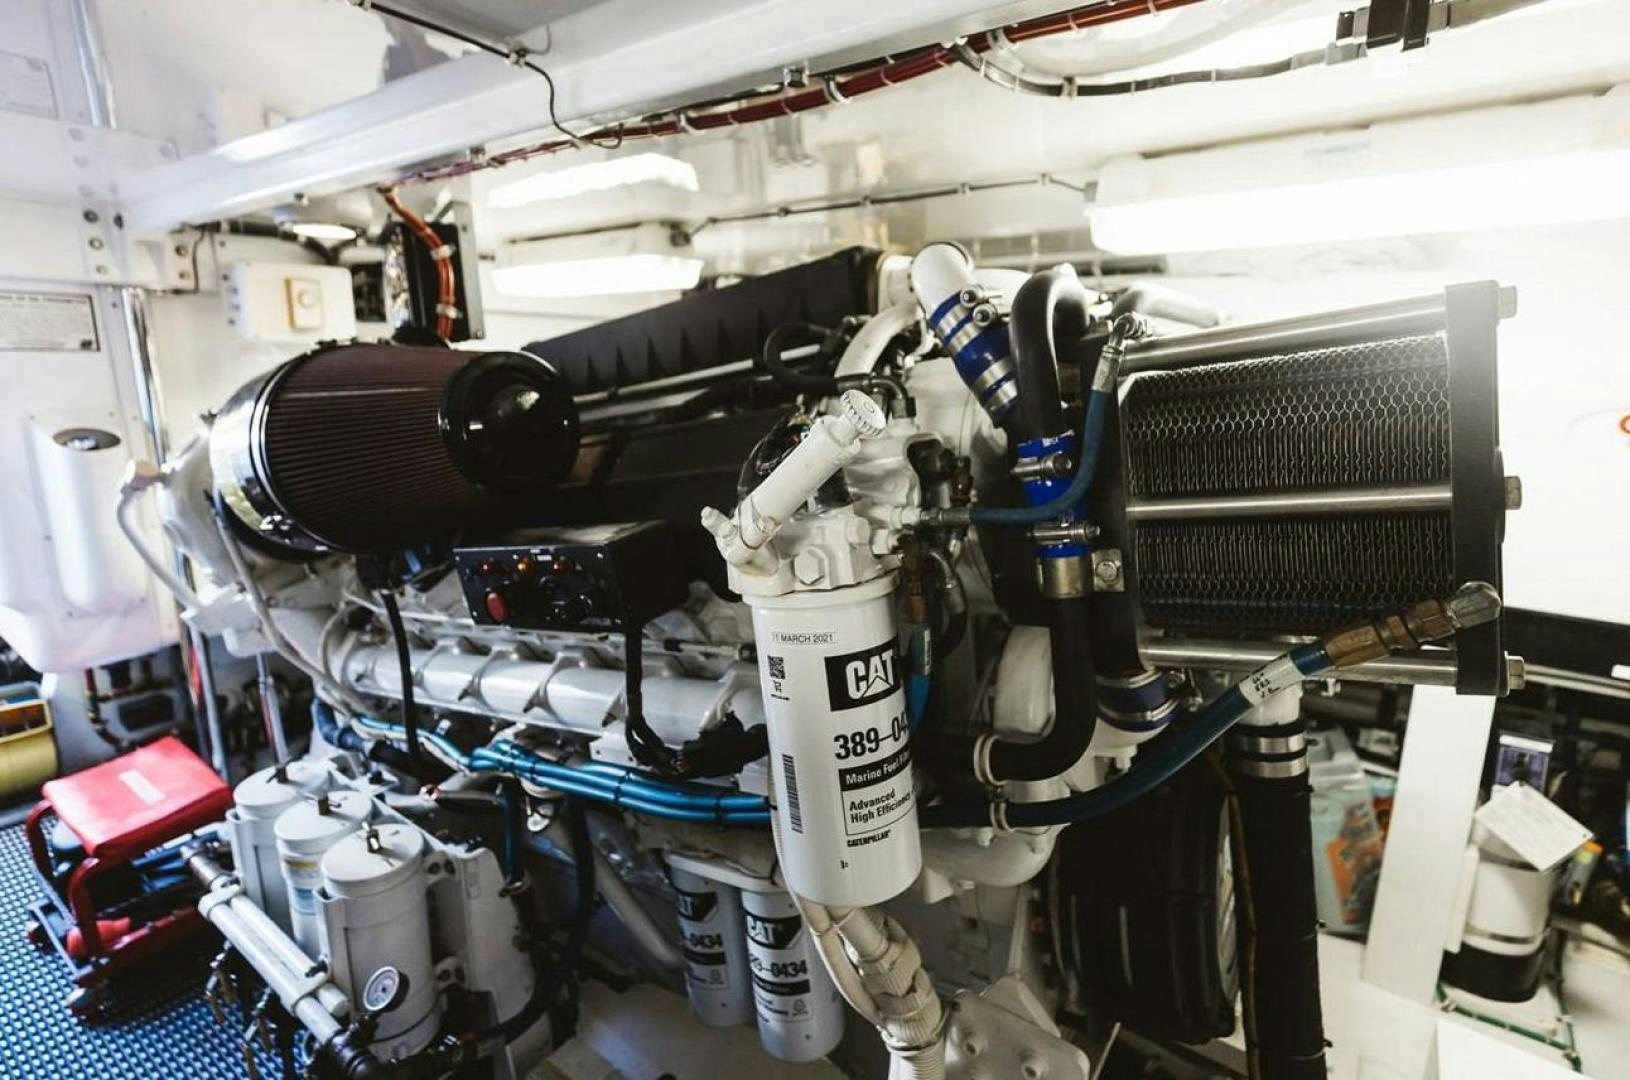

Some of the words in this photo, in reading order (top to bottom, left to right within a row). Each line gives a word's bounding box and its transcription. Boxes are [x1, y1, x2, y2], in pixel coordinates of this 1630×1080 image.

[781, 633, 811, 643] MARCH
[813, 633, 833, 643] 2021
[845, 648, 894, 700] CAT
[846, 769, 882, 785] Marine
[883, 757, 900, 775] Fuel
[849, 788, 895, 811] Advanced
[851, 810, 875, 824] High
